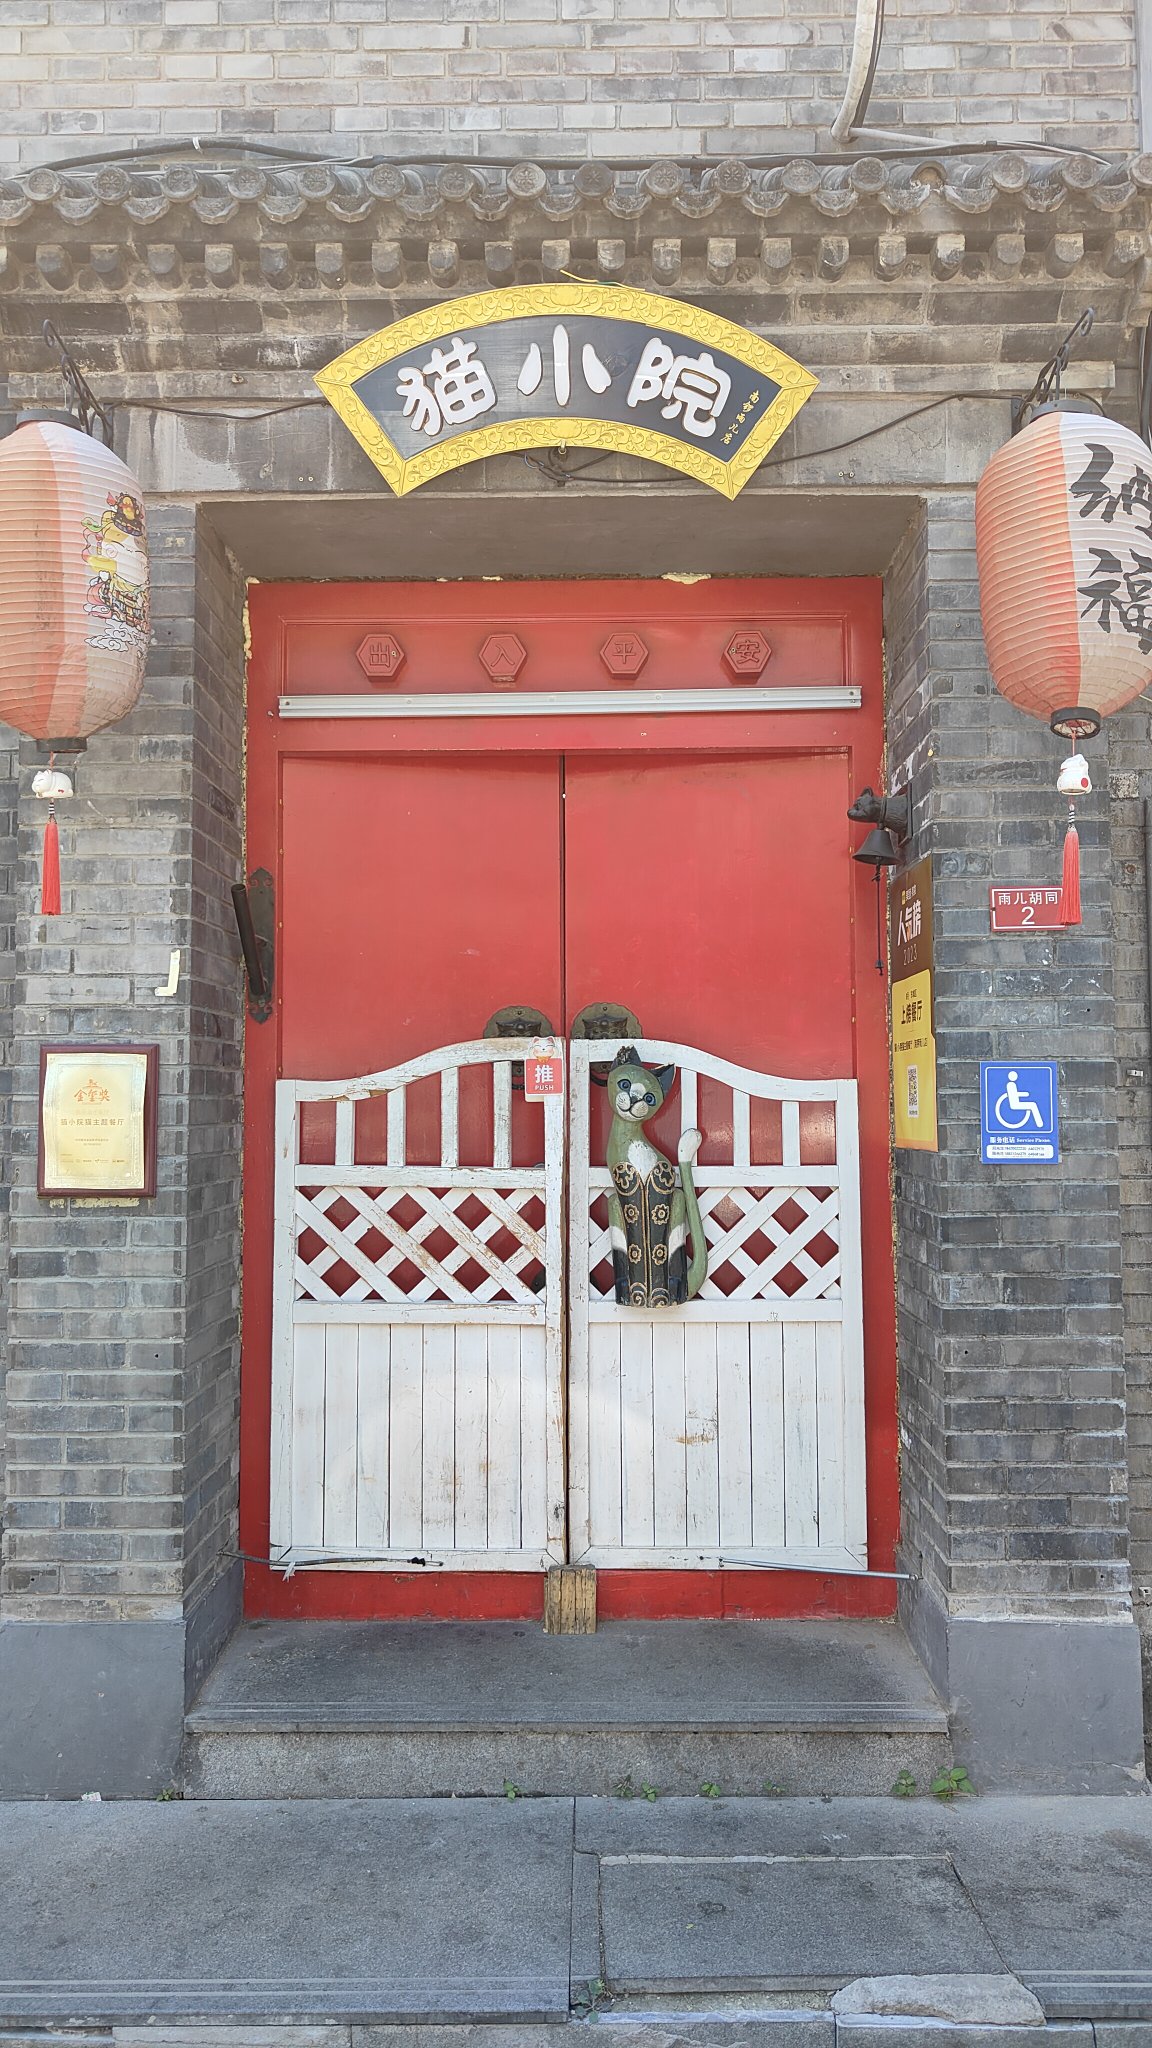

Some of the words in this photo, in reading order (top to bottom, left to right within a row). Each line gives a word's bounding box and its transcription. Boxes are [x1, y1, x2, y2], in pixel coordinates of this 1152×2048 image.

[395, 323, 732, 437] 猫小院
[998, 891, 1059, 906] 雨儿胡同
[897, 899, 922, 947] 人气榜
[1021, 906, 1035, 925] 2
[903, 943, 918, 966] 2023
[535, 1064, 554, 1083] 推
